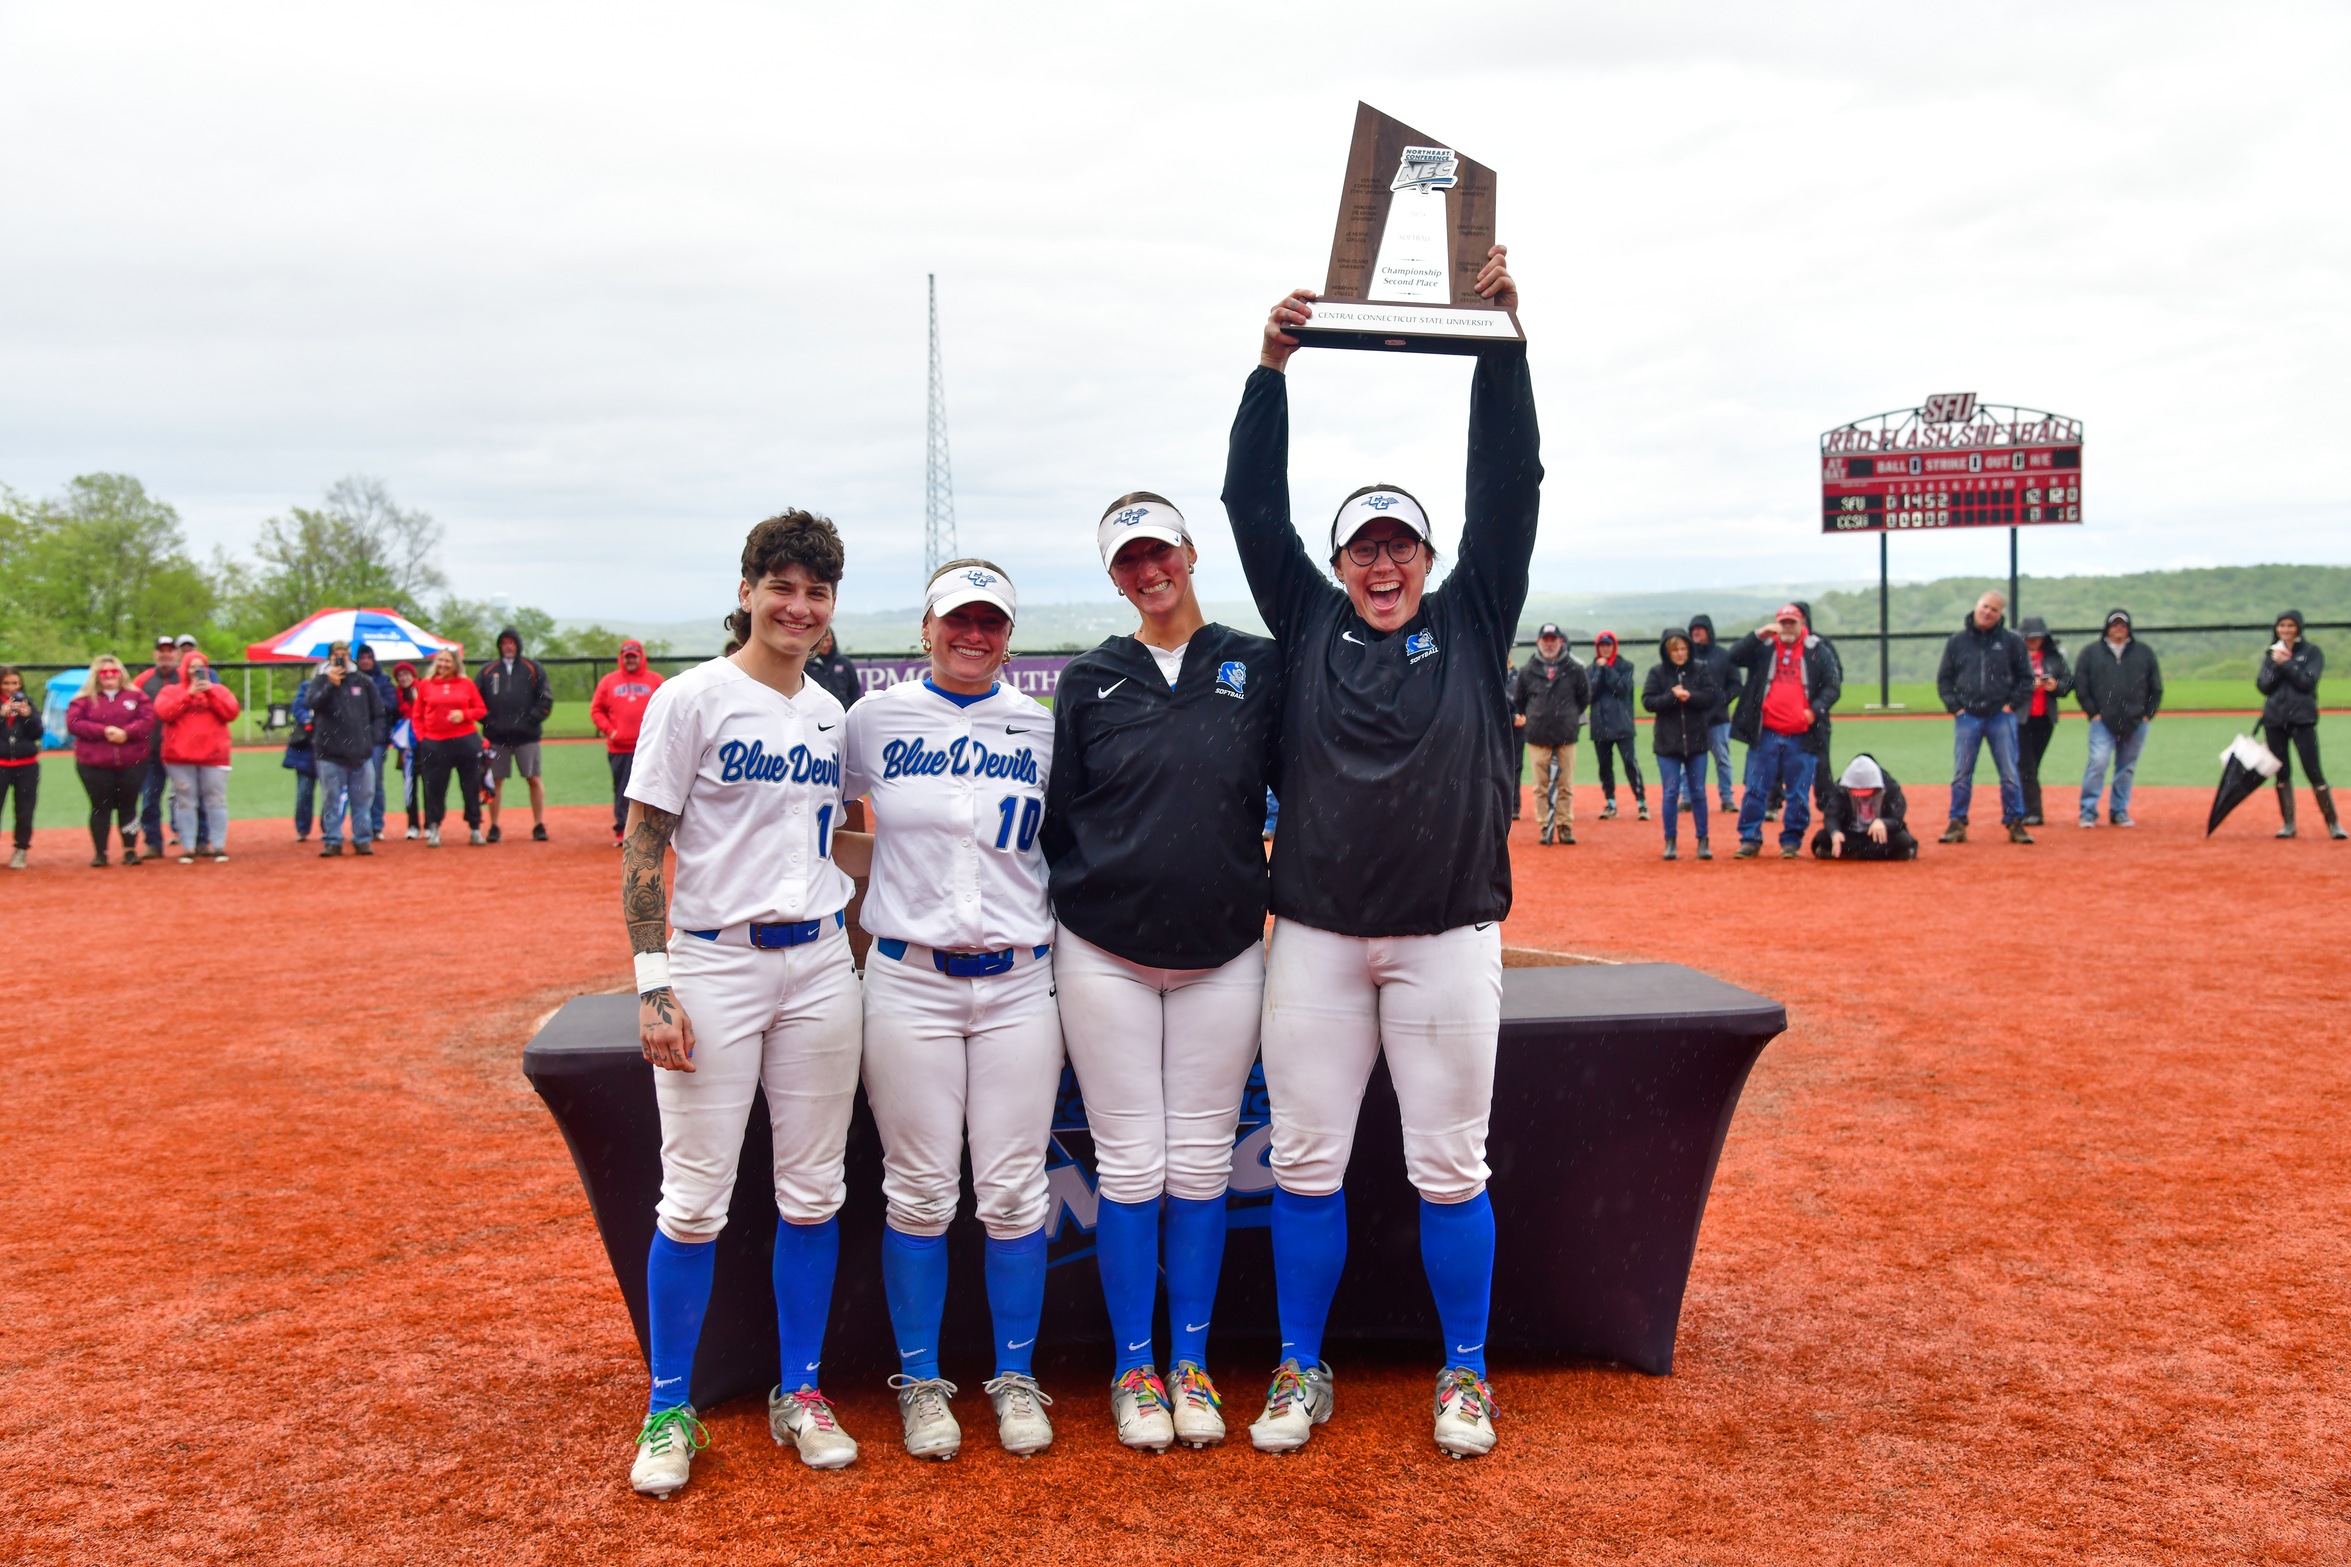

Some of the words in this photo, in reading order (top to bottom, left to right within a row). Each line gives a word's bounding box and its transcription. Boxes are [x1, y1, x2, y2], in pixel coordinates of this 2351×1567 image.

[1398, 160, 1454, 181] NEC
[1381, 266, 1442, 277] Championship
[1383, 278, 1414, 287] Second
[1416, 279, 1438, 288] Place
[1318, 311, 1354, 320] CENTRAL
[1357, 313, 1417, 323] CONNECTICUT
[1419, 316, 1444, 325] STATE
[1447, 318, 1495, 327] UNIVERSITY
[1923, 393, 1976, 423] SFU
[1827, 429, 1872, 452] RED
[1879, 424, 1952, 450] FLASH
[1959, 419, 2080, 445] SOFTBALL
[1877, 460, 1907, 474] BALL
[1925, 457, 1967, 471] STRIKE
[1985, 455, 2010, 469] OUT
[1841, 496, 1866, 511] SFU
[1410, 646, 1439, 665] SOFTBALL
[1215, 687, 1245, 700] SOFTBALL
[719, 738, 790, 783] Blue
[787, 743, 840, 789] Devil
[882, 736, 950, 780] Blue
[949, 735, 1038, 785] Devils
[994, 794, 1045, 853] 10
